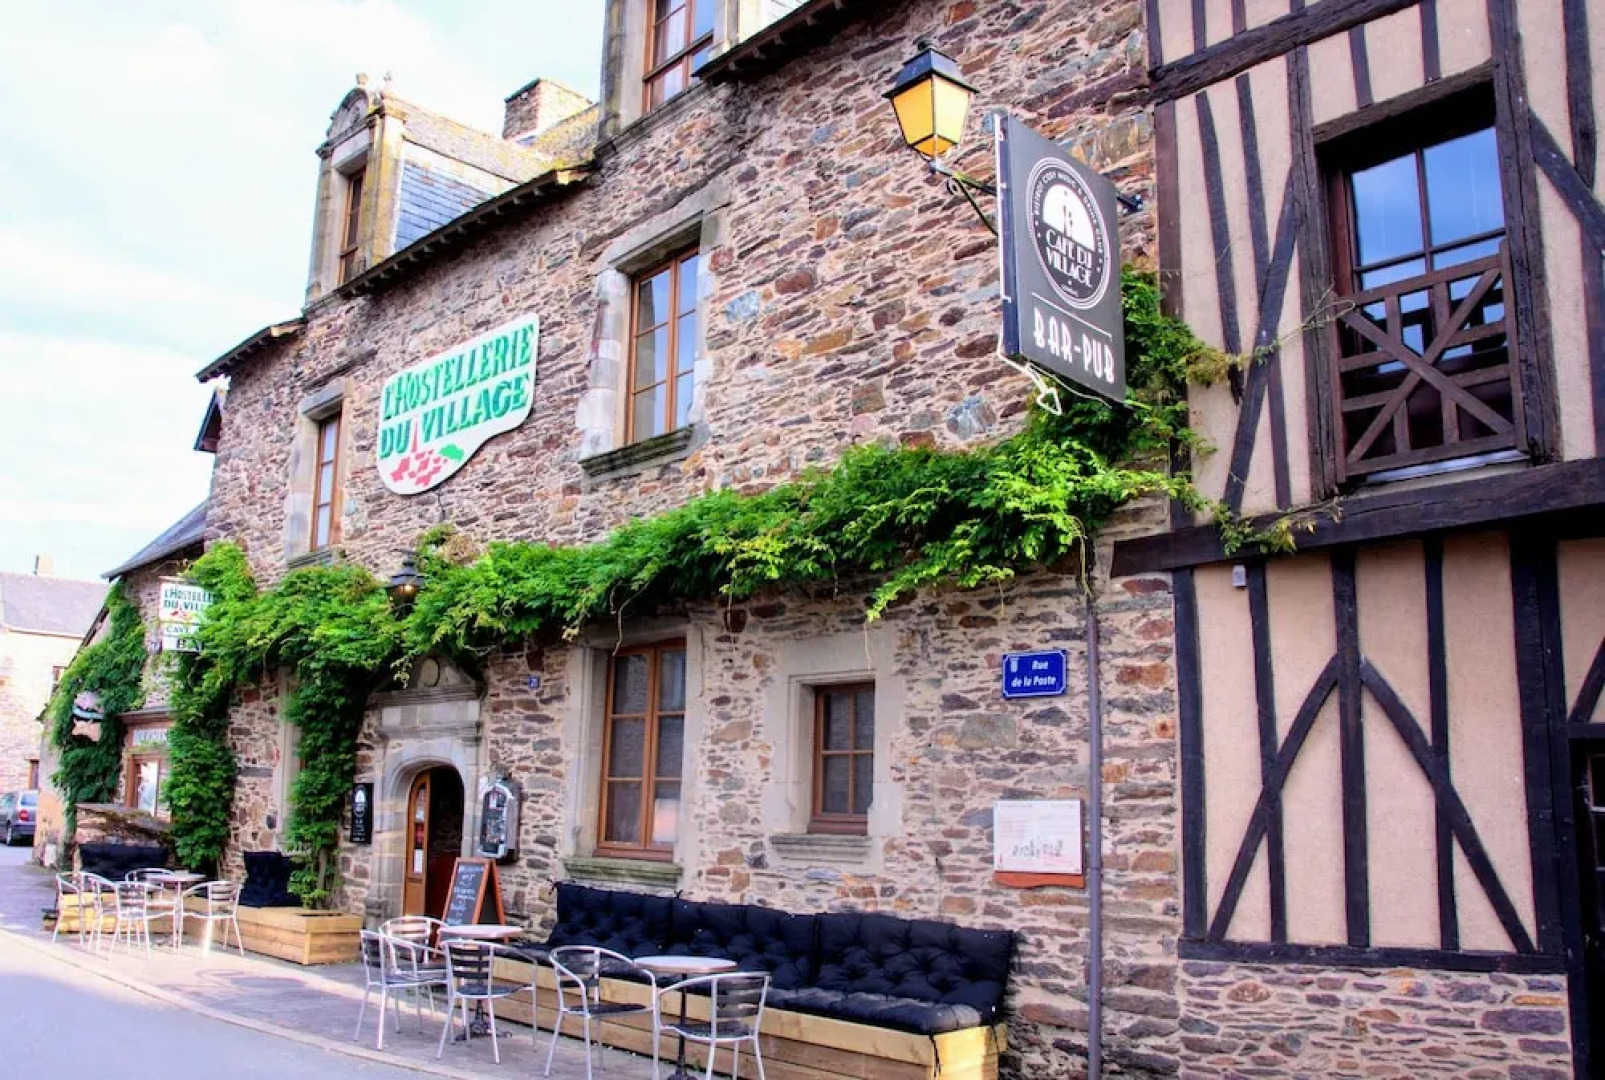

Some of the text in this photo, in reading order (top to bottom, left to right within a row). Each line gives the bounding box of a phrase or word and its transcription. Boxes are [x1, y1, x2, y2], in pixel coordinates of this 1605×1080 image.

[1045, 246, 1093, 288] VILLAGE
[1033, 308, 1115, 384] BAR-PUB
[383, 323, 534, 421] L'HOSTELLERIE
[379, 372, 529, 460] DU VILLAGE
[164, 599, 179, 609] DU
[1011, 675, 1056, 687] de la Poste
[1032, 661, 1049, 670] Rue
